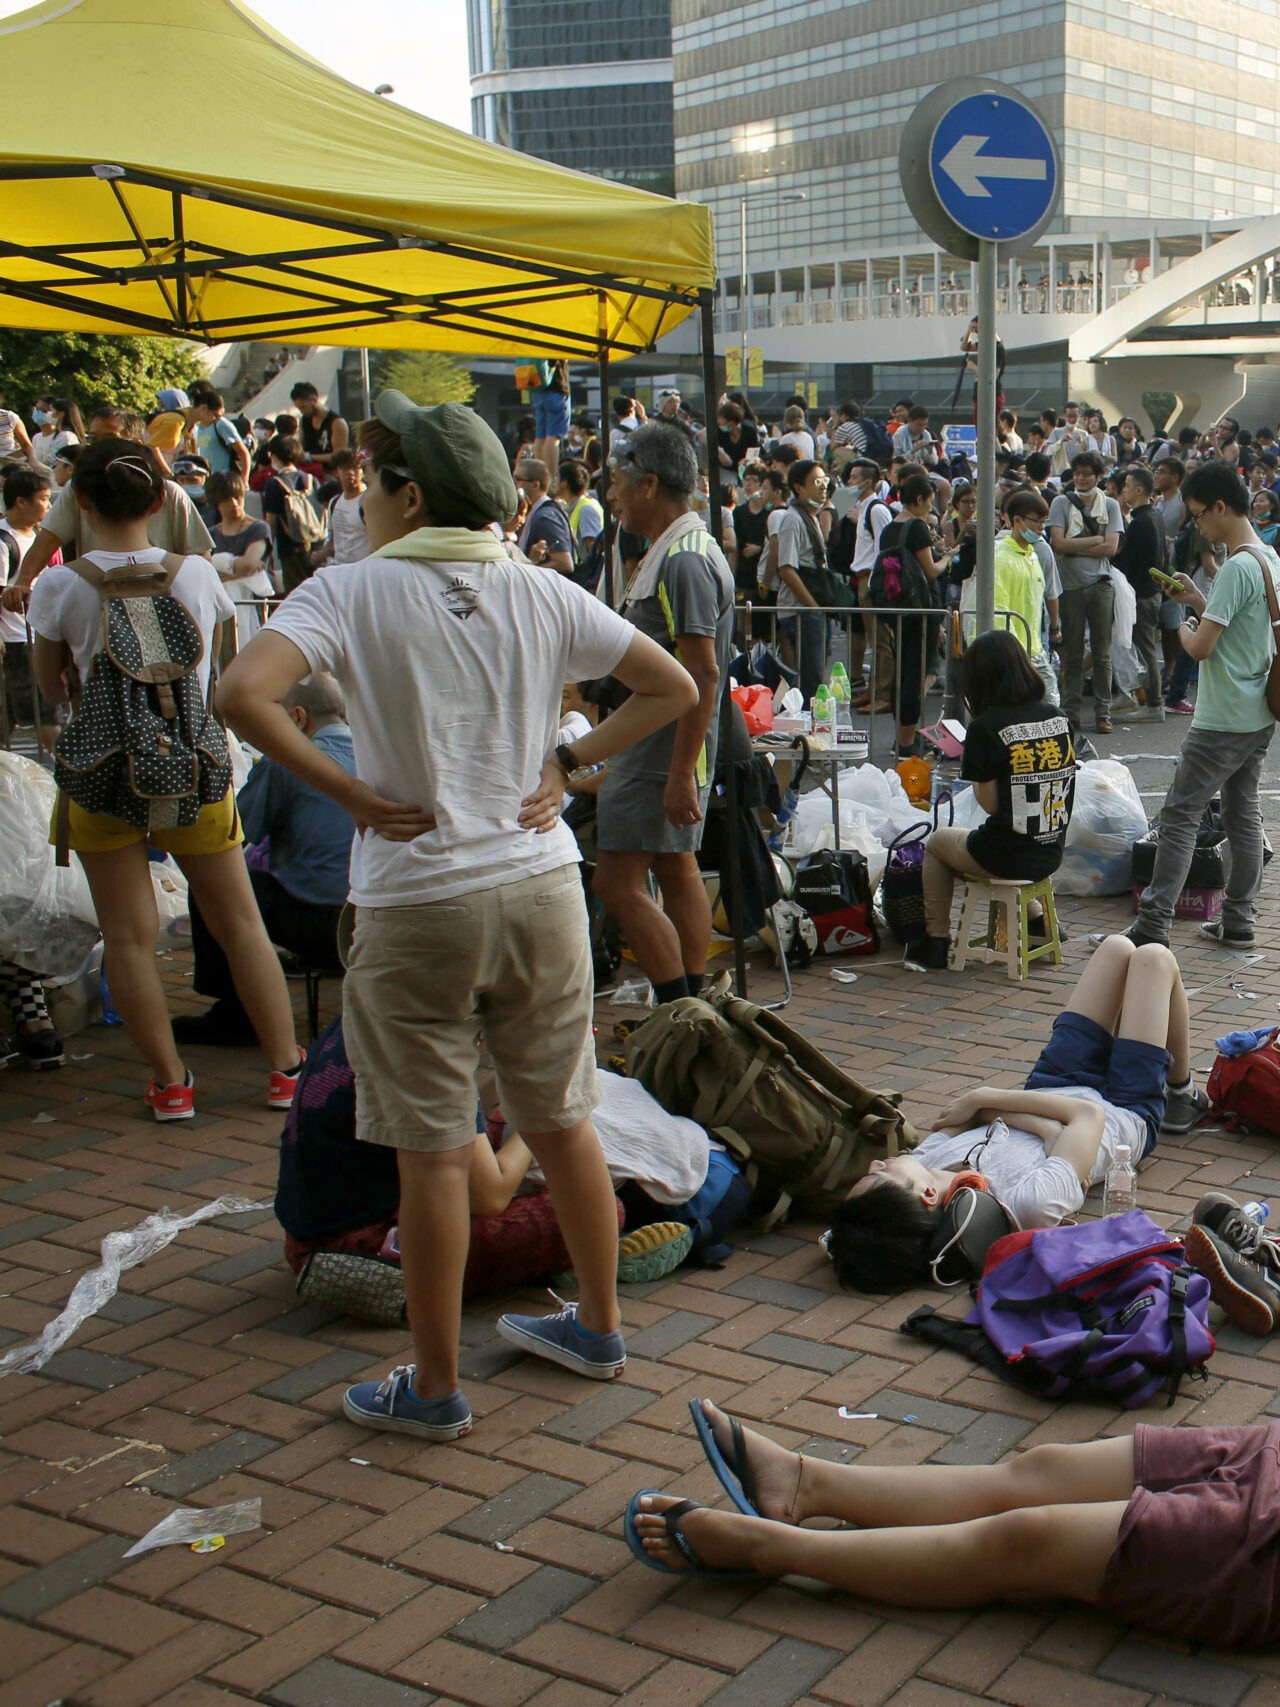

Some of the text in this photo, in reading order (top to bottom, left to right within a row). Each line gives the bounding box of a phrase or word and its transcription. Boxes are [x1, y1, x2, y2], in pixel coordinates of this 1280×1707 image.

[1009, 733, 1076, 774] 香港人
[1011, 774, 1037, 783] PROTECT
